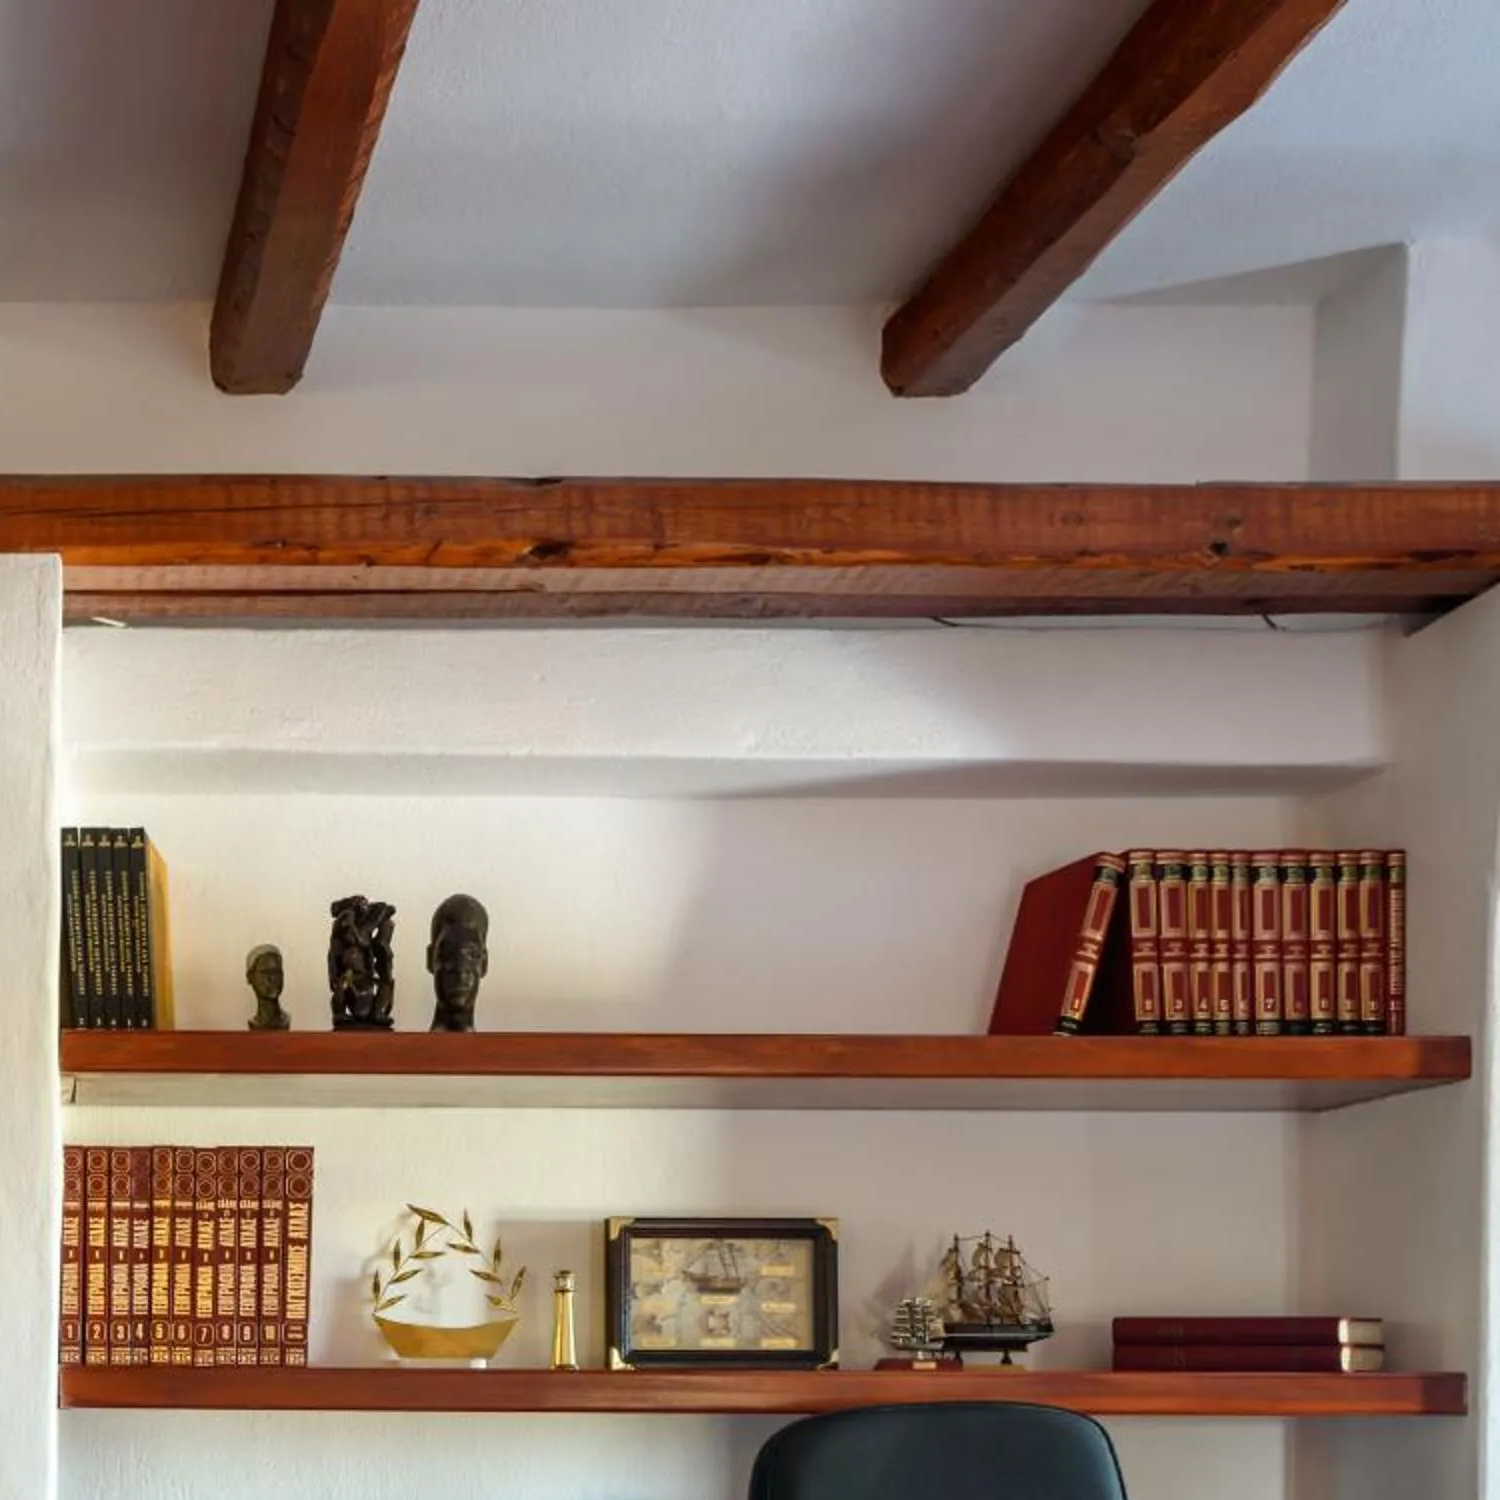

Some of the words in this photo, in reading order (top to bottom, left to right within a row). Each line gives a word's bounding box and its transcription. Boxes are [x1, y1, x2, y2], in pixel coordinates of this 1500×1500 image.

[289, 1202, 308, 1238] ΑΤΛΑΣ
[67, 1325, 74, 1338] 1
[92, 1325, 101, 1338] 2
[116, 1325, 125, 1338] 3
[135, 1323, 144, 1339] 4
[155, 1323, 164, 1338] 5
[200, 1327, 208, 1341] 7
[243, 1325, 251, 1339] 9
